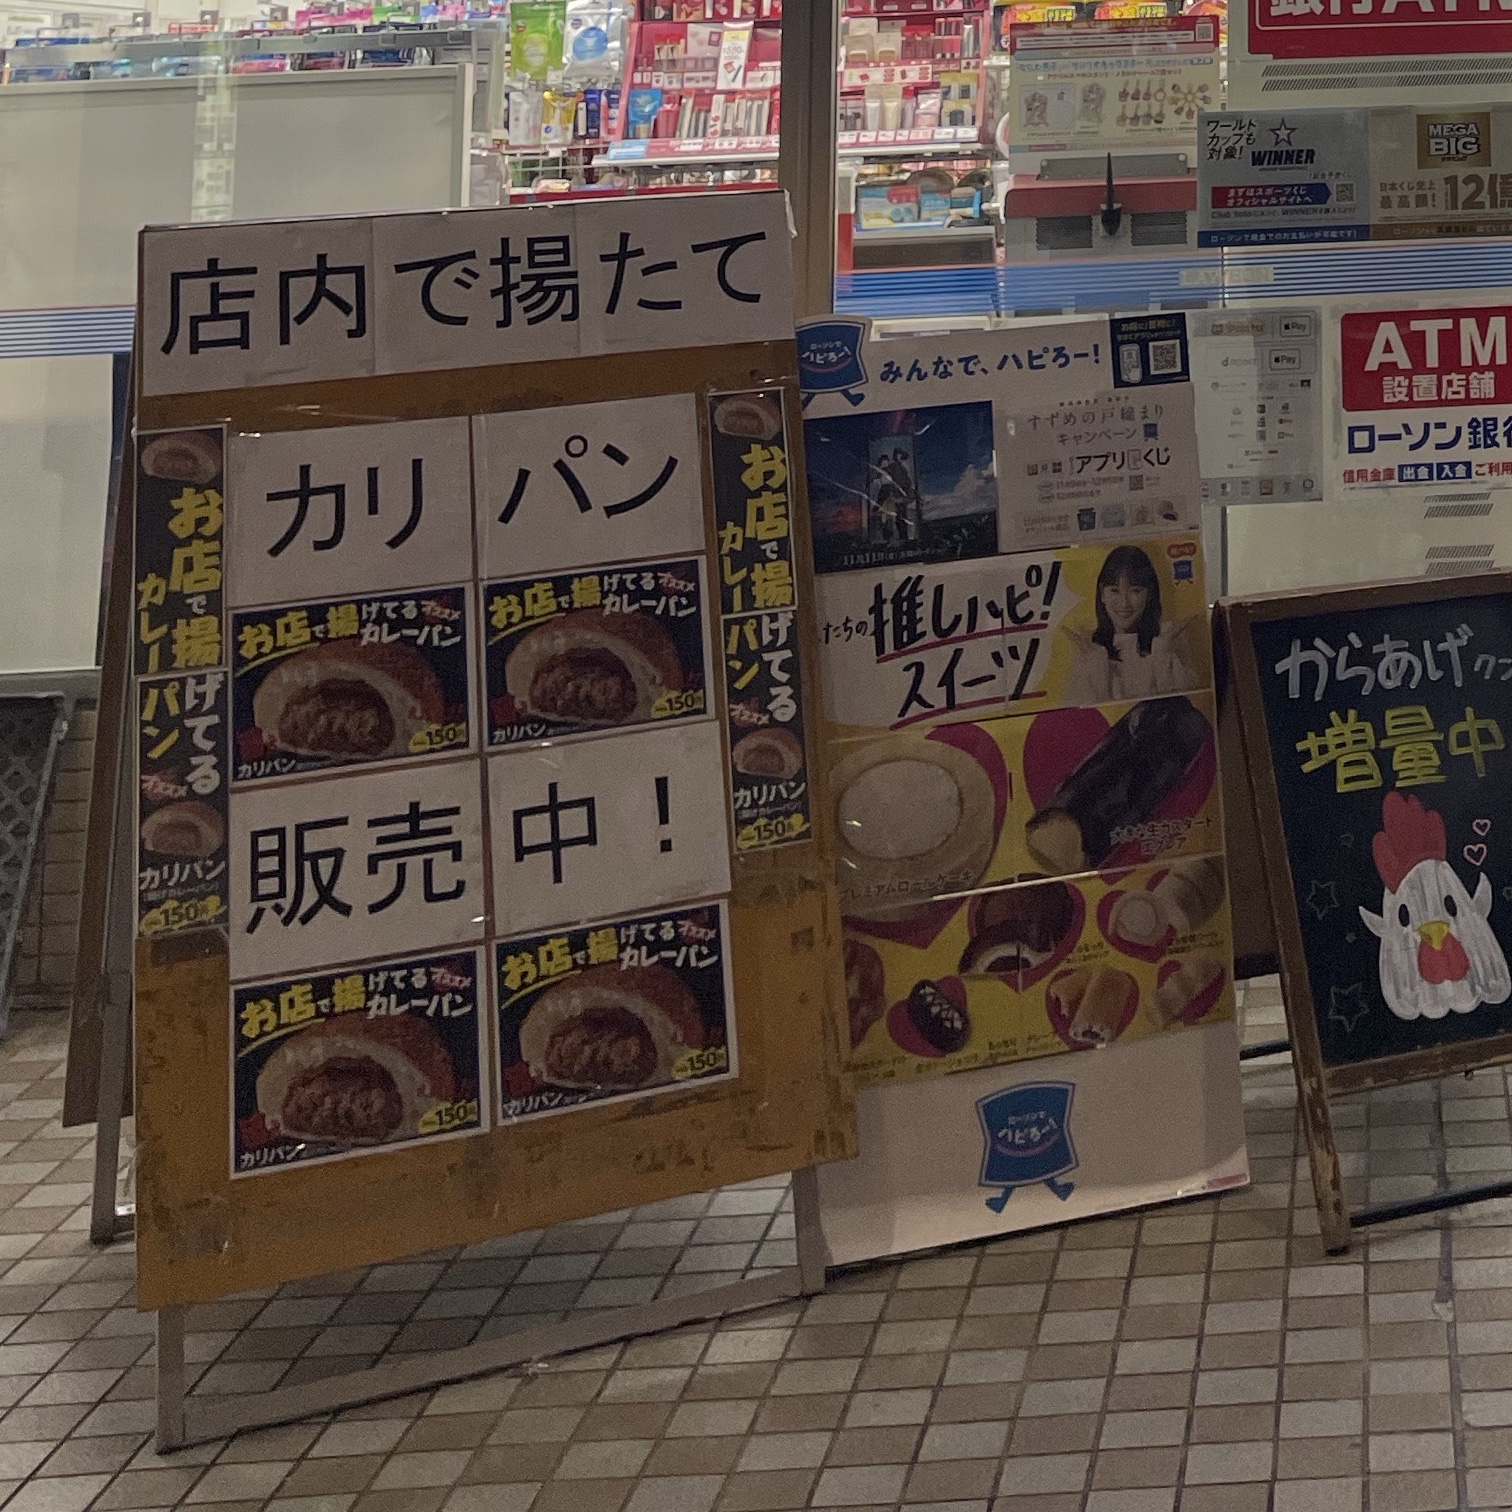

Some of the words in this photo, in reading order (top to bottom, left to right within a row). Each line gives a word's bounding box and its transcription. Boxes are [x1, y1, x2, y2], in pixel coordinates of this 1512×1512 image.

[1207, 118, 1258, 133] ワールド
[1428, 123, 1479, 137] MEGA
[1250, 148, 1315, 168] WINNER
[1428, 136, 1481, 156] BIG
[160, 230, 768, 356] 店内で揚たて
[1363, 315, 1508, 372] ATM
[1382, 371, 1496, 403] 設置店舗
[1076, 450, 1126, 474] アプリ
[1143, 447, 1171, 467] くじ
[1343, 466, 1396, 483] 信用金庫
[1402, 464, 1430, 480] 出金
[1440, 463, 1468, 478] 入金
[266, 434, 679, 558] カリパン
[896, 636, 1041, 720] スイーツ
[1296, 704, 1506, 794] 増量中
[734, 781, 806, 809] カリパン
[139, 857, 226, 890] カリパン
